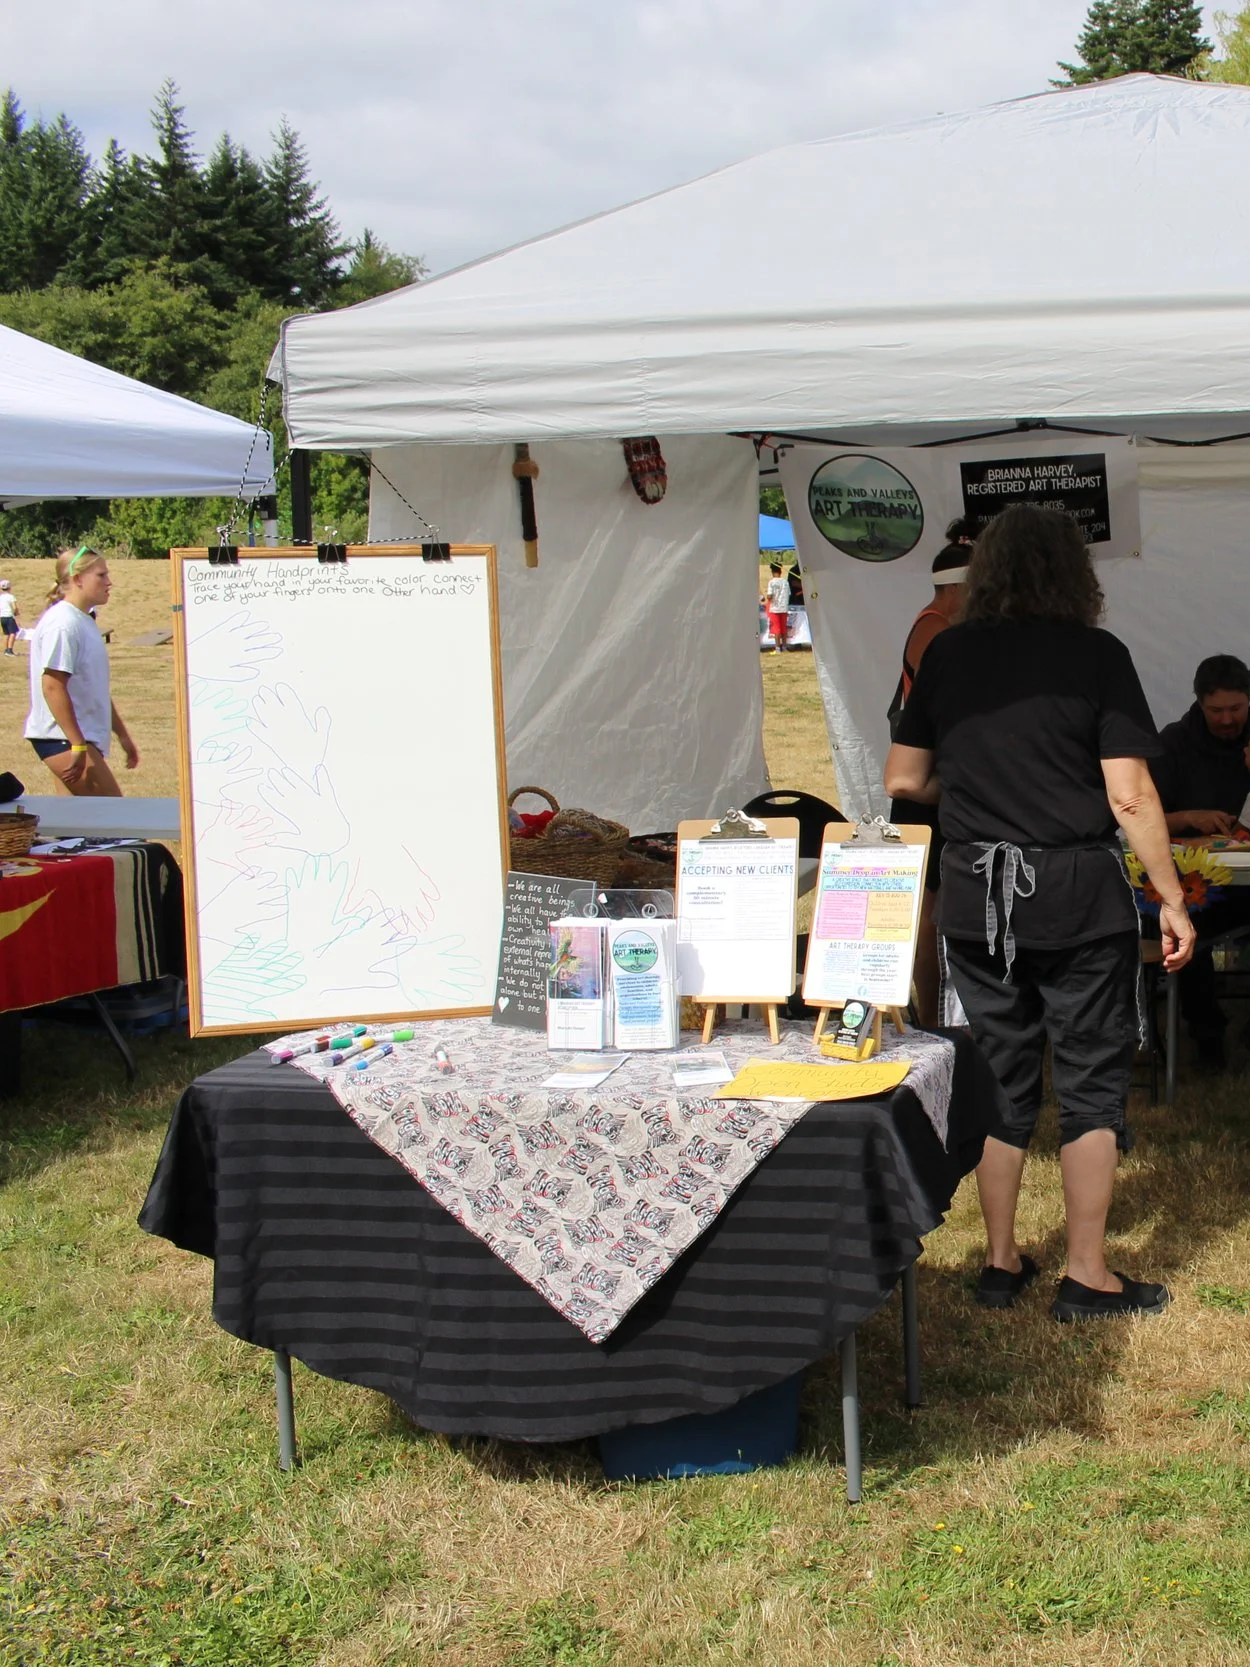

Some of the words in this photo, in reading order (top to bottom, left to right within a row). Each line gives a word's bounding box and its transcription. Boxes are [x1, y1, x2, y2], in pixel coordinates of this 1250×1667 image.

[988, 467, 1032, 482] BRIANNA
[1034, 464, 1077, 479] HARVEY,
[967, 480, 1025, 495] REGISTERED
[1028, 479, 1048, 492] ART
[1051, 475, 1102, 491] THERAPIST
[813, 486, 843, 498] PEAKS
[847, 488, 867, 498] AND
[871, 488, 915, 500] VALLEYS
[814, 499, 842, 517] ART
[848, 501, 918, 520] THERAPY
[188, 563, 258, 583] Community
[267, 562, 349, 580] Handprints
[189, 582, 220, 593] Trace
[253, 579, 285, 588] hand
[308, 577, 332, 590] your
[336, 575, 391, 588] favorite
[394, 574, 426, 586] color
[433, 573, 482, 584] connect
[194, 593, 219, 605] one
[240, 590, 267, 605] your
[273, 586, 312, 602] fingers
[352, 585, 375, 595] one
[421, 584, 456, 596] hand
[682, 865, 733, 876] ACCEPTING
[736, 865, 756, 875] NEW
[759, 864, 794, 875] CLIENTS
[528, 884, 542, 893] are
[546, 883, 560, 894] all
[510, 893, 542, 904] creative
[548, 896, 575, 911] beings
[524, 905, 535, 915] all
[539, 907, 558, 918] have
[507, 915, 532, 929] ability
[535, 916, 543, 926] to
[531, 925, 550, 936] heal
[504, 946, 532, 957] external
[503, 955, 511, 963] of
[503, 966, 541, 982] internally
[520, 978, 528, 988] do
[532, 981, 545, 991] not
[500, 986, 520, 997] alone
[523, 989, 537, 1000] but
[517, 1000, 524, 1011] to
[528, 1006, 541, 1014] one
